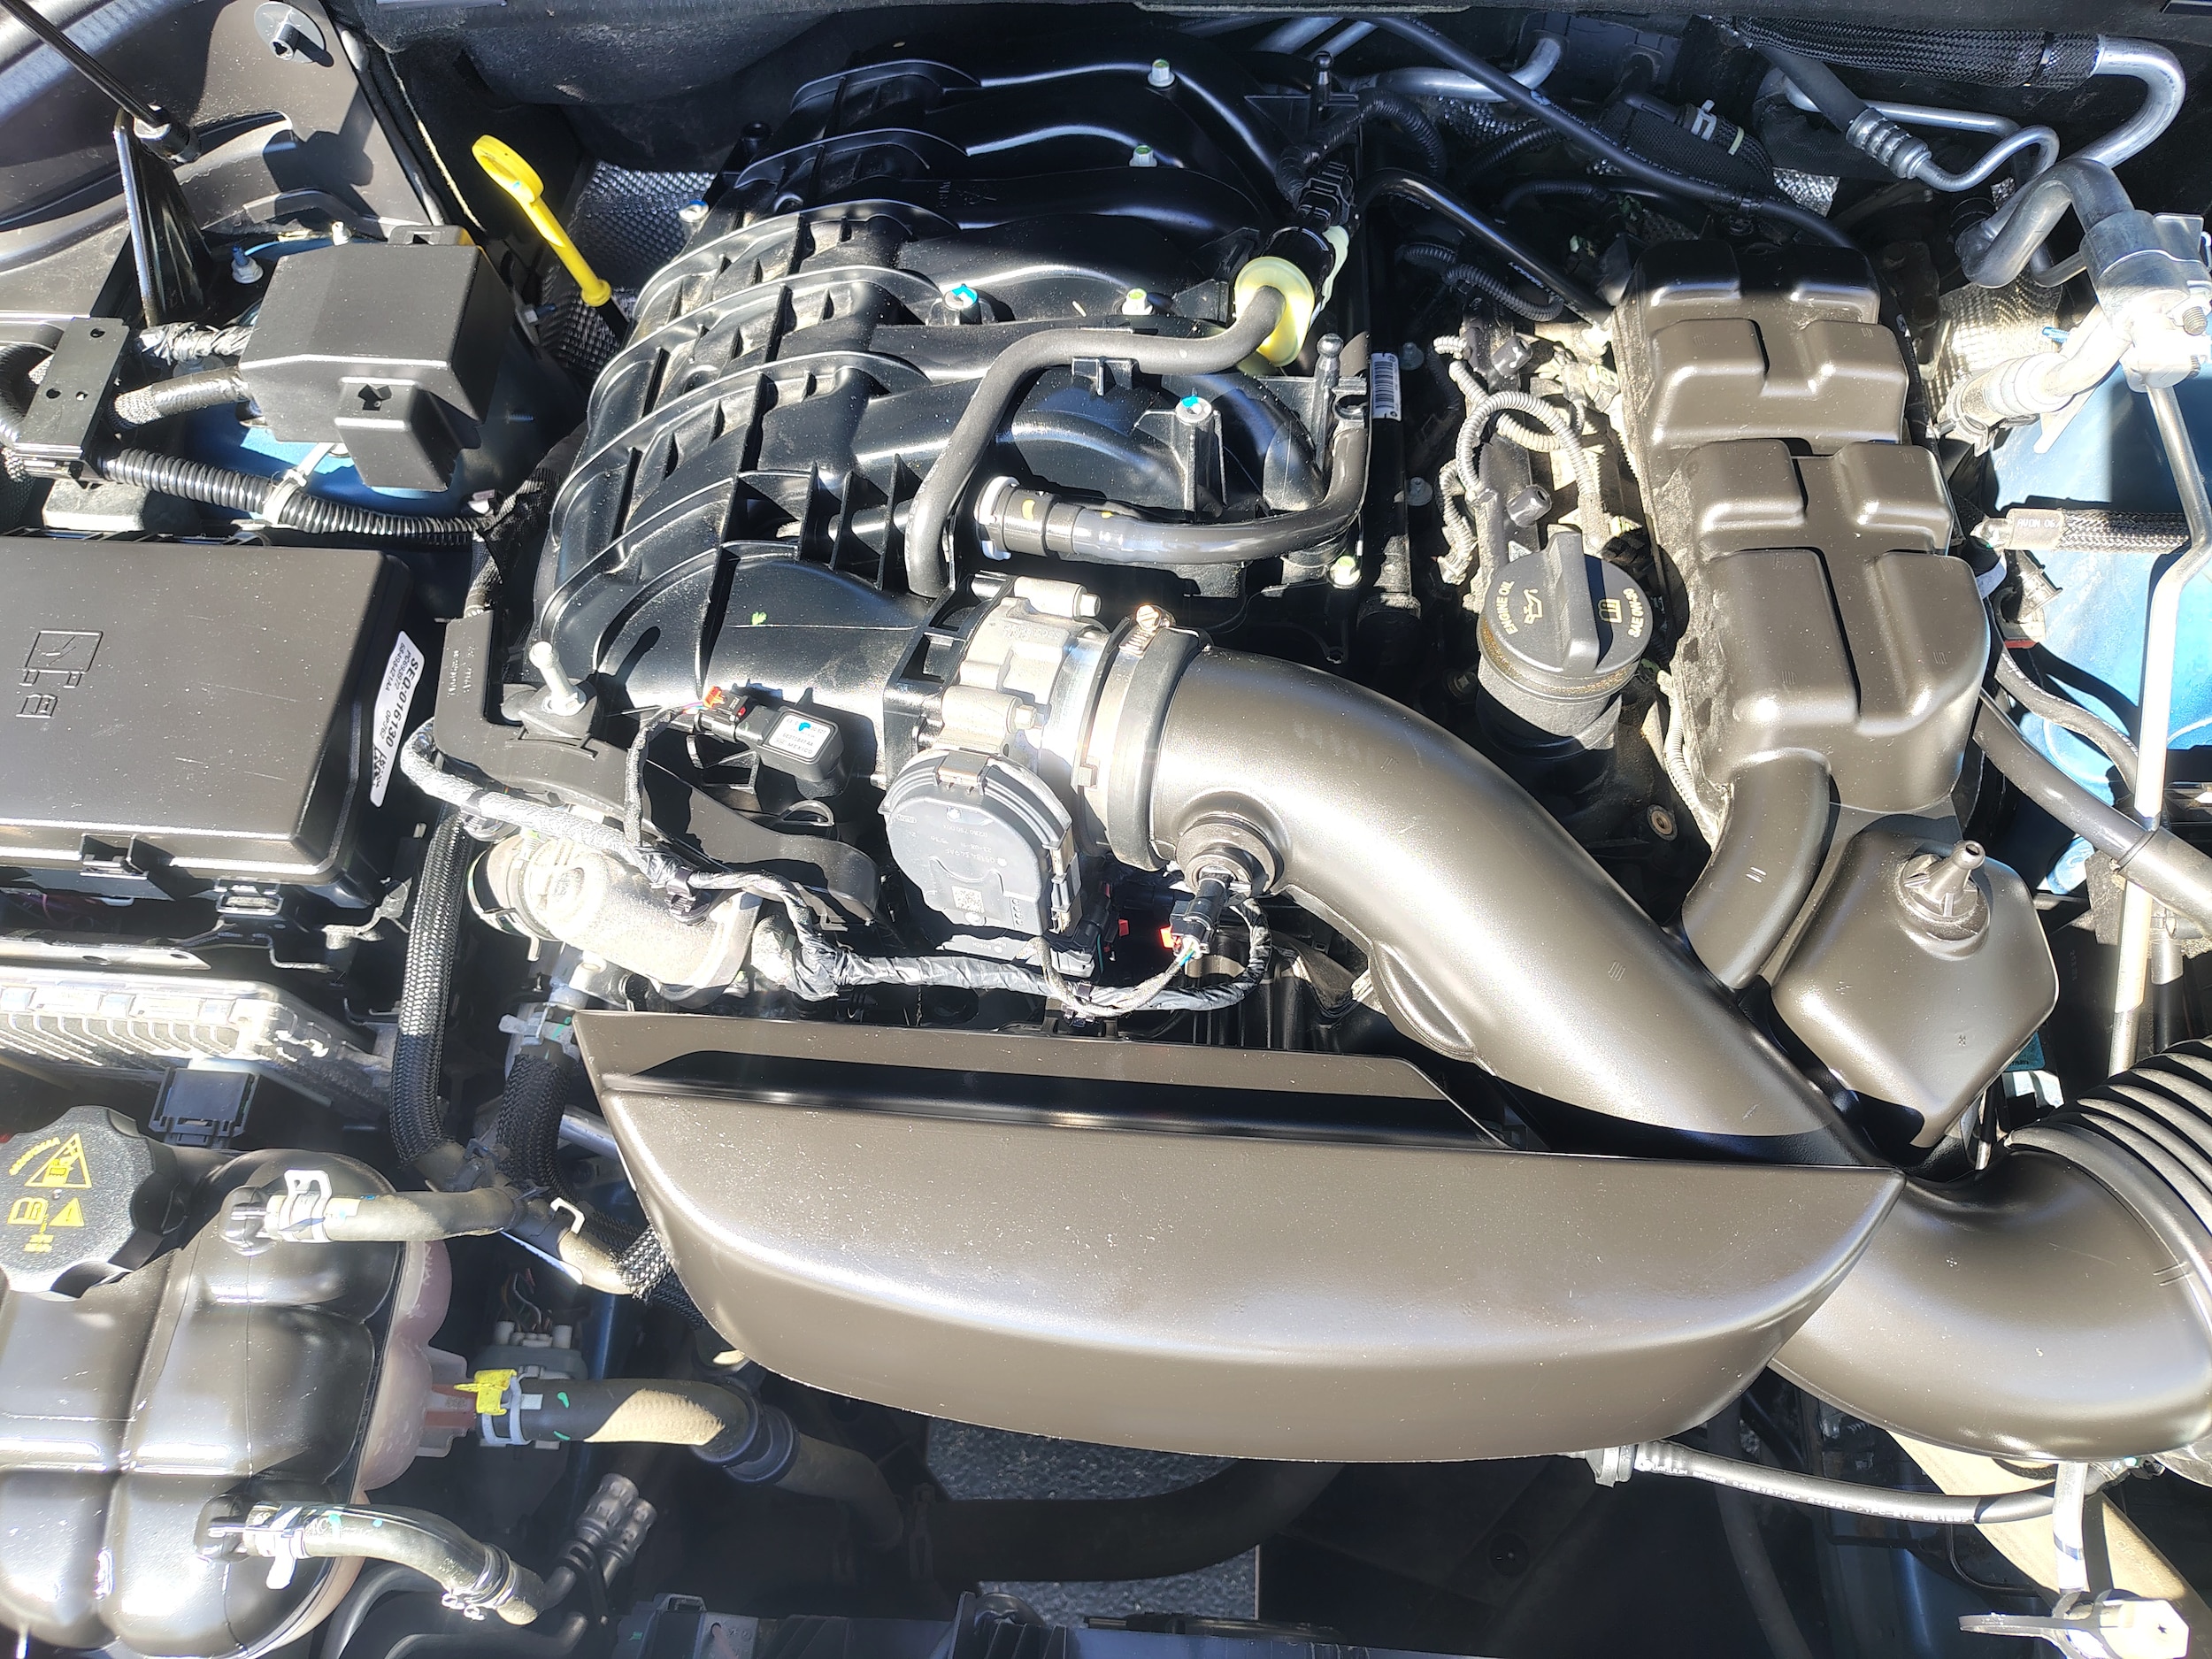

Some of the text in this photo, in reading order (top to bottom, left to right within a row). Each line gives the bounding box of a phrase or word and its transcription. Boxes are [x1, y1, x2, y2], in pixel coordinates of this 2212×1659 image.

[1498, 580, 1516, 596] OIL
[1496, 596, 1519, 635] ENGINE
[1623, 588, 1644, 638] SAE 0W-20
[787, 742, 813, 754] MEXICO
[972, 941, 992, 950] BOSCH
